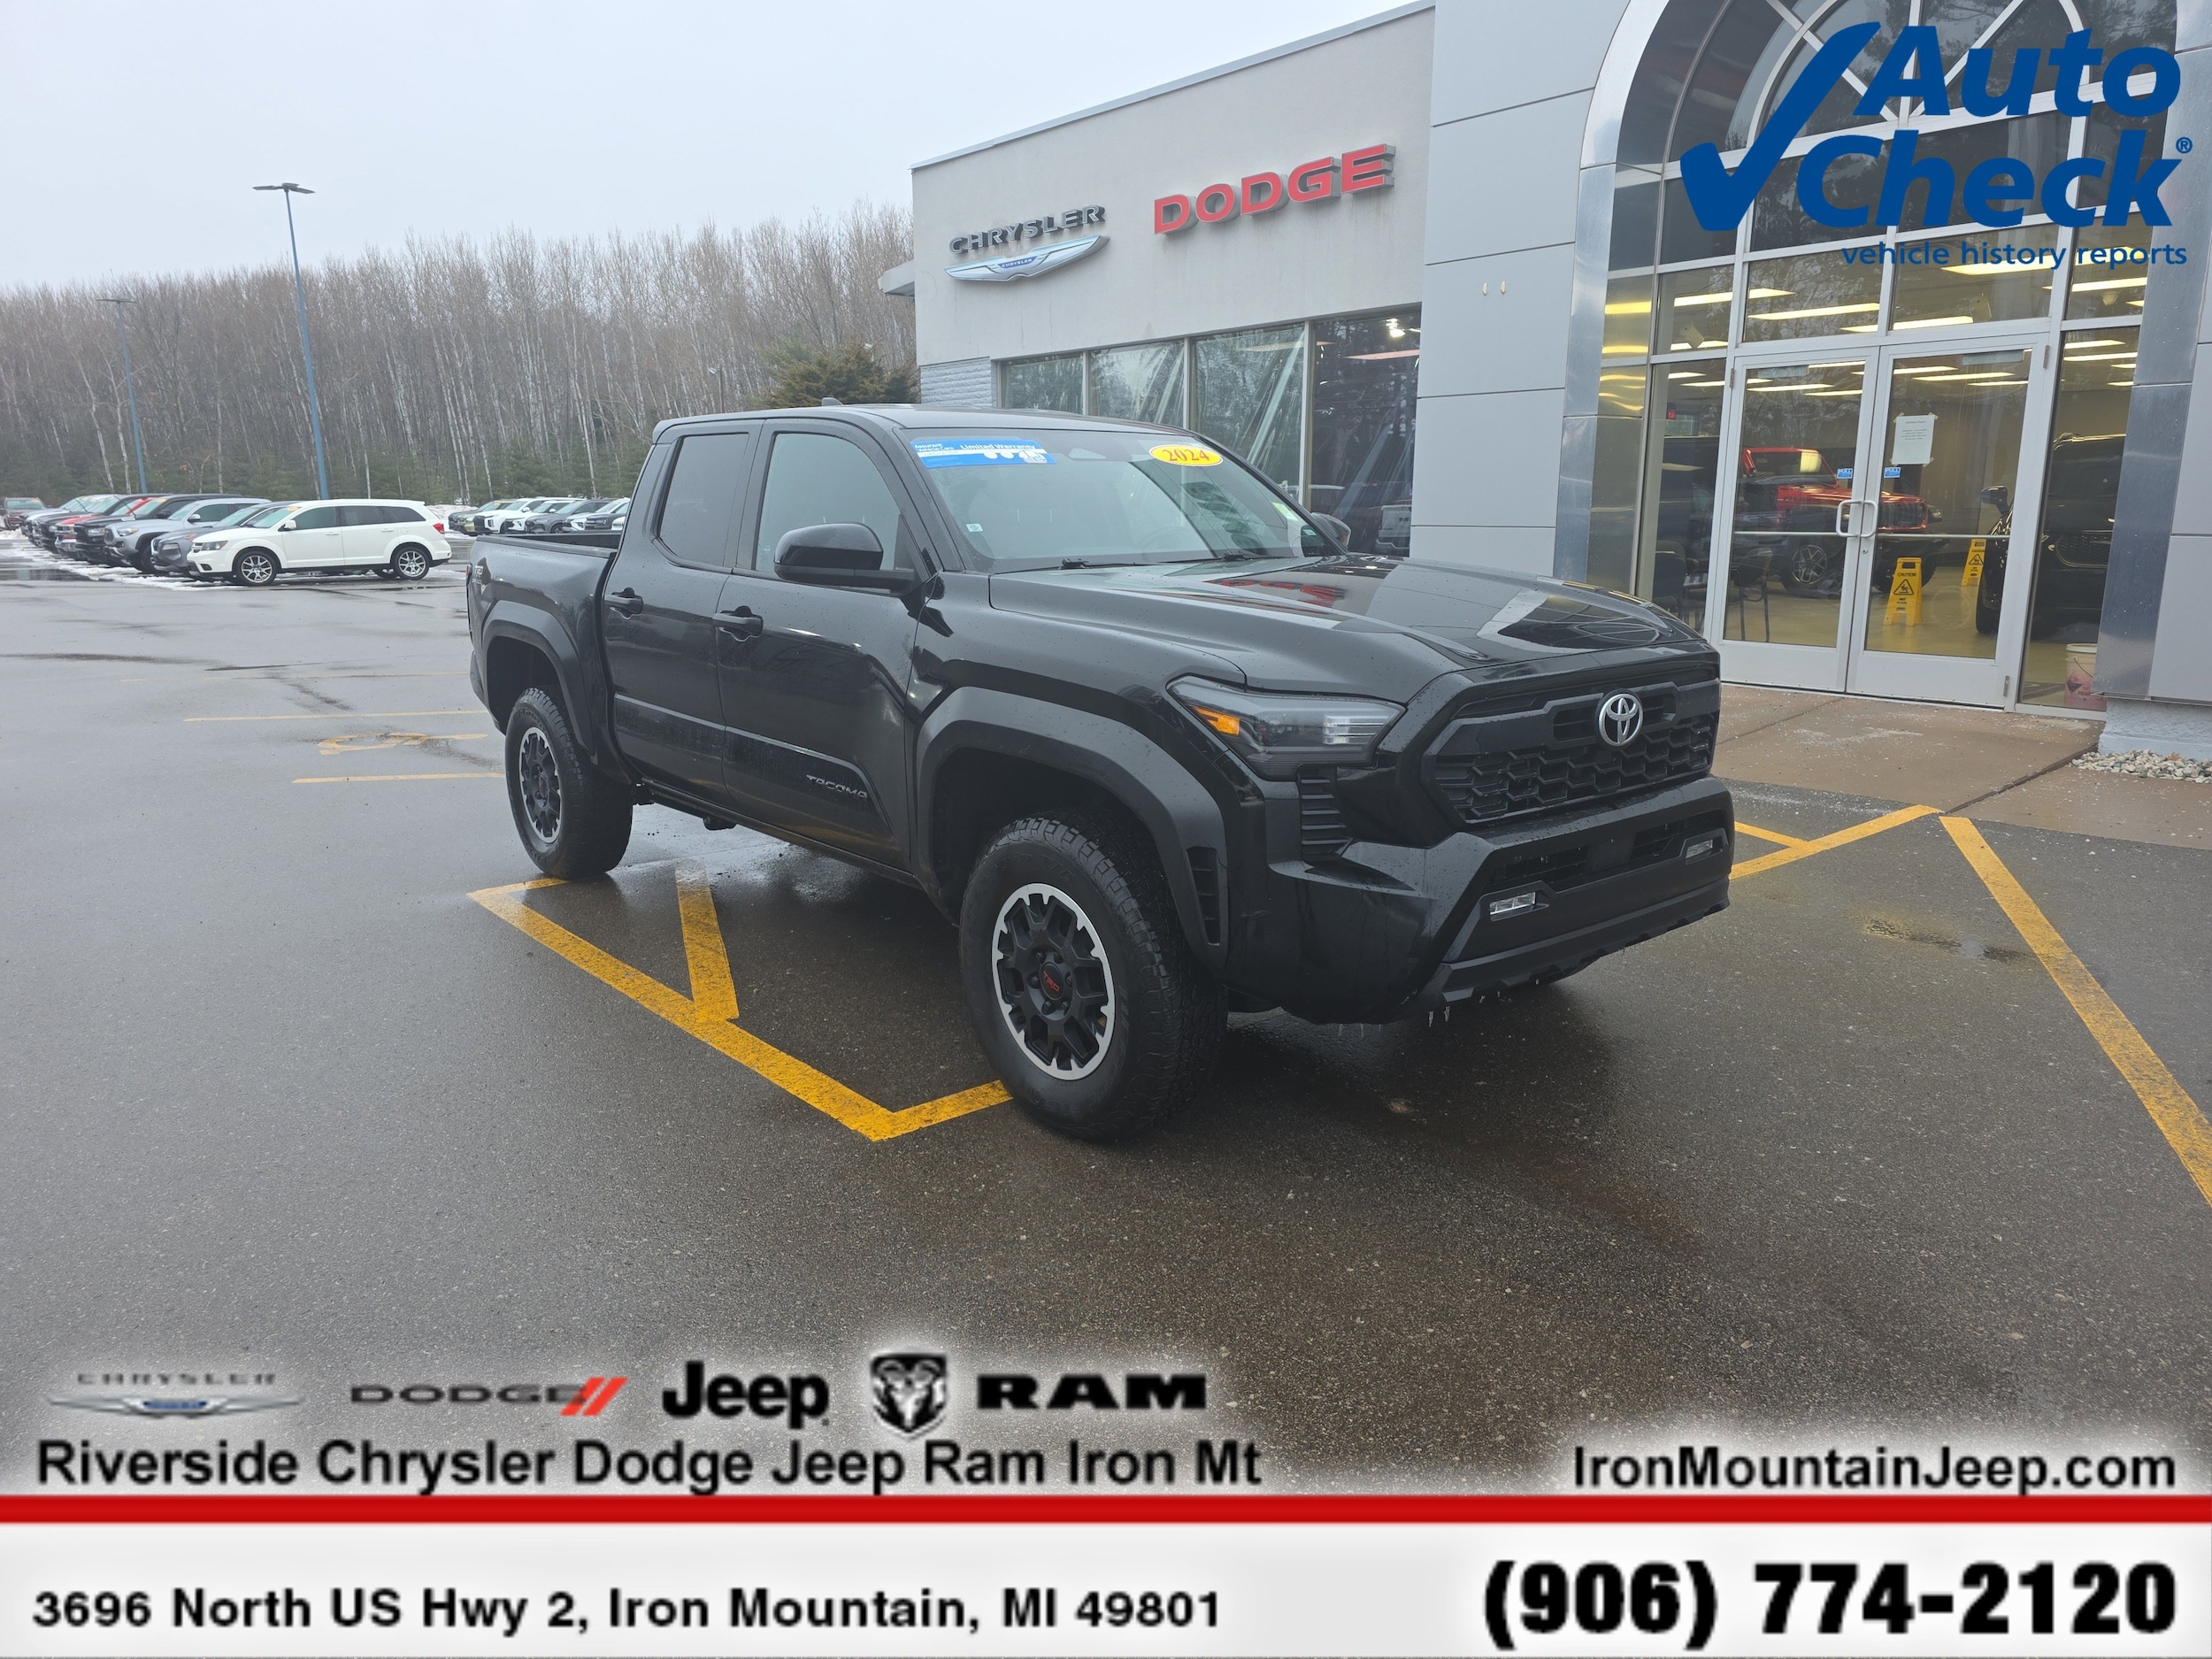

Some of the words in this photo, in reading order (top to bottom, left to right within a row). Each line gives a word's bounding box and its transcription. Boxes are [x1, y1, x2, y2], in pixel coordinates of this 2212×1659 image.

[1154, 143, 1395, 236] DODGE
[949, 204, 1106, 255] CHRYSLER
[1002, 257, 1033, 268] CHRYSLER
[1162, 449, 1210, 462] 2024
[806, 774, 868, 799] TACOMA
[1043, 971, 1061, 992] TRD
